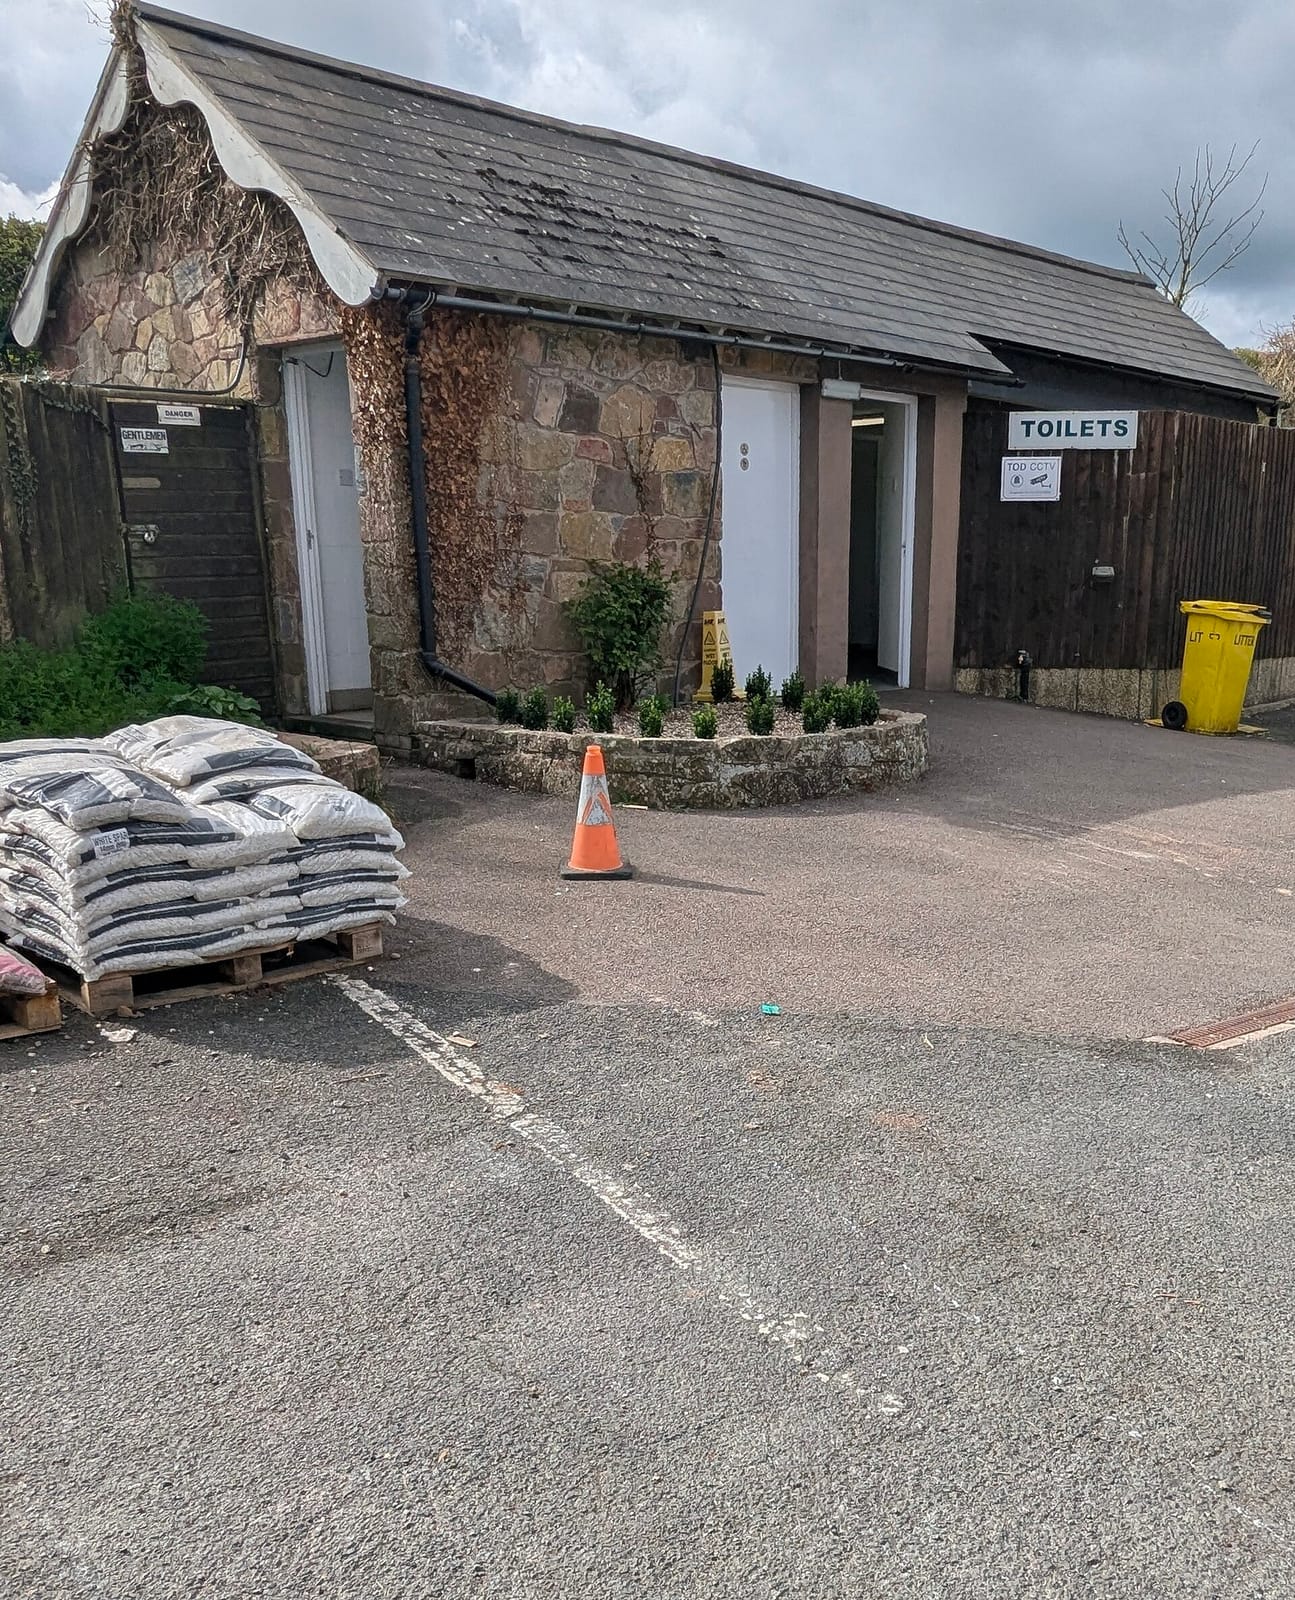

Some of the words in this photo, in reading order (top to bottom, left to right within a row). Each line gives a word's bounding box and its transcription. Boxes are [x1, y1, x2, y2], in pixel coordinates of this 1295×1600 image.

[1021, 420, 1128, 437] TOILETS
[122, 430, 167, 440] GENTLEMEN
[1007, 462, 1027, 471] TOD
[1030, 462, 1056, 471] CCTV
[92, 835, 113, 847] WHITE
